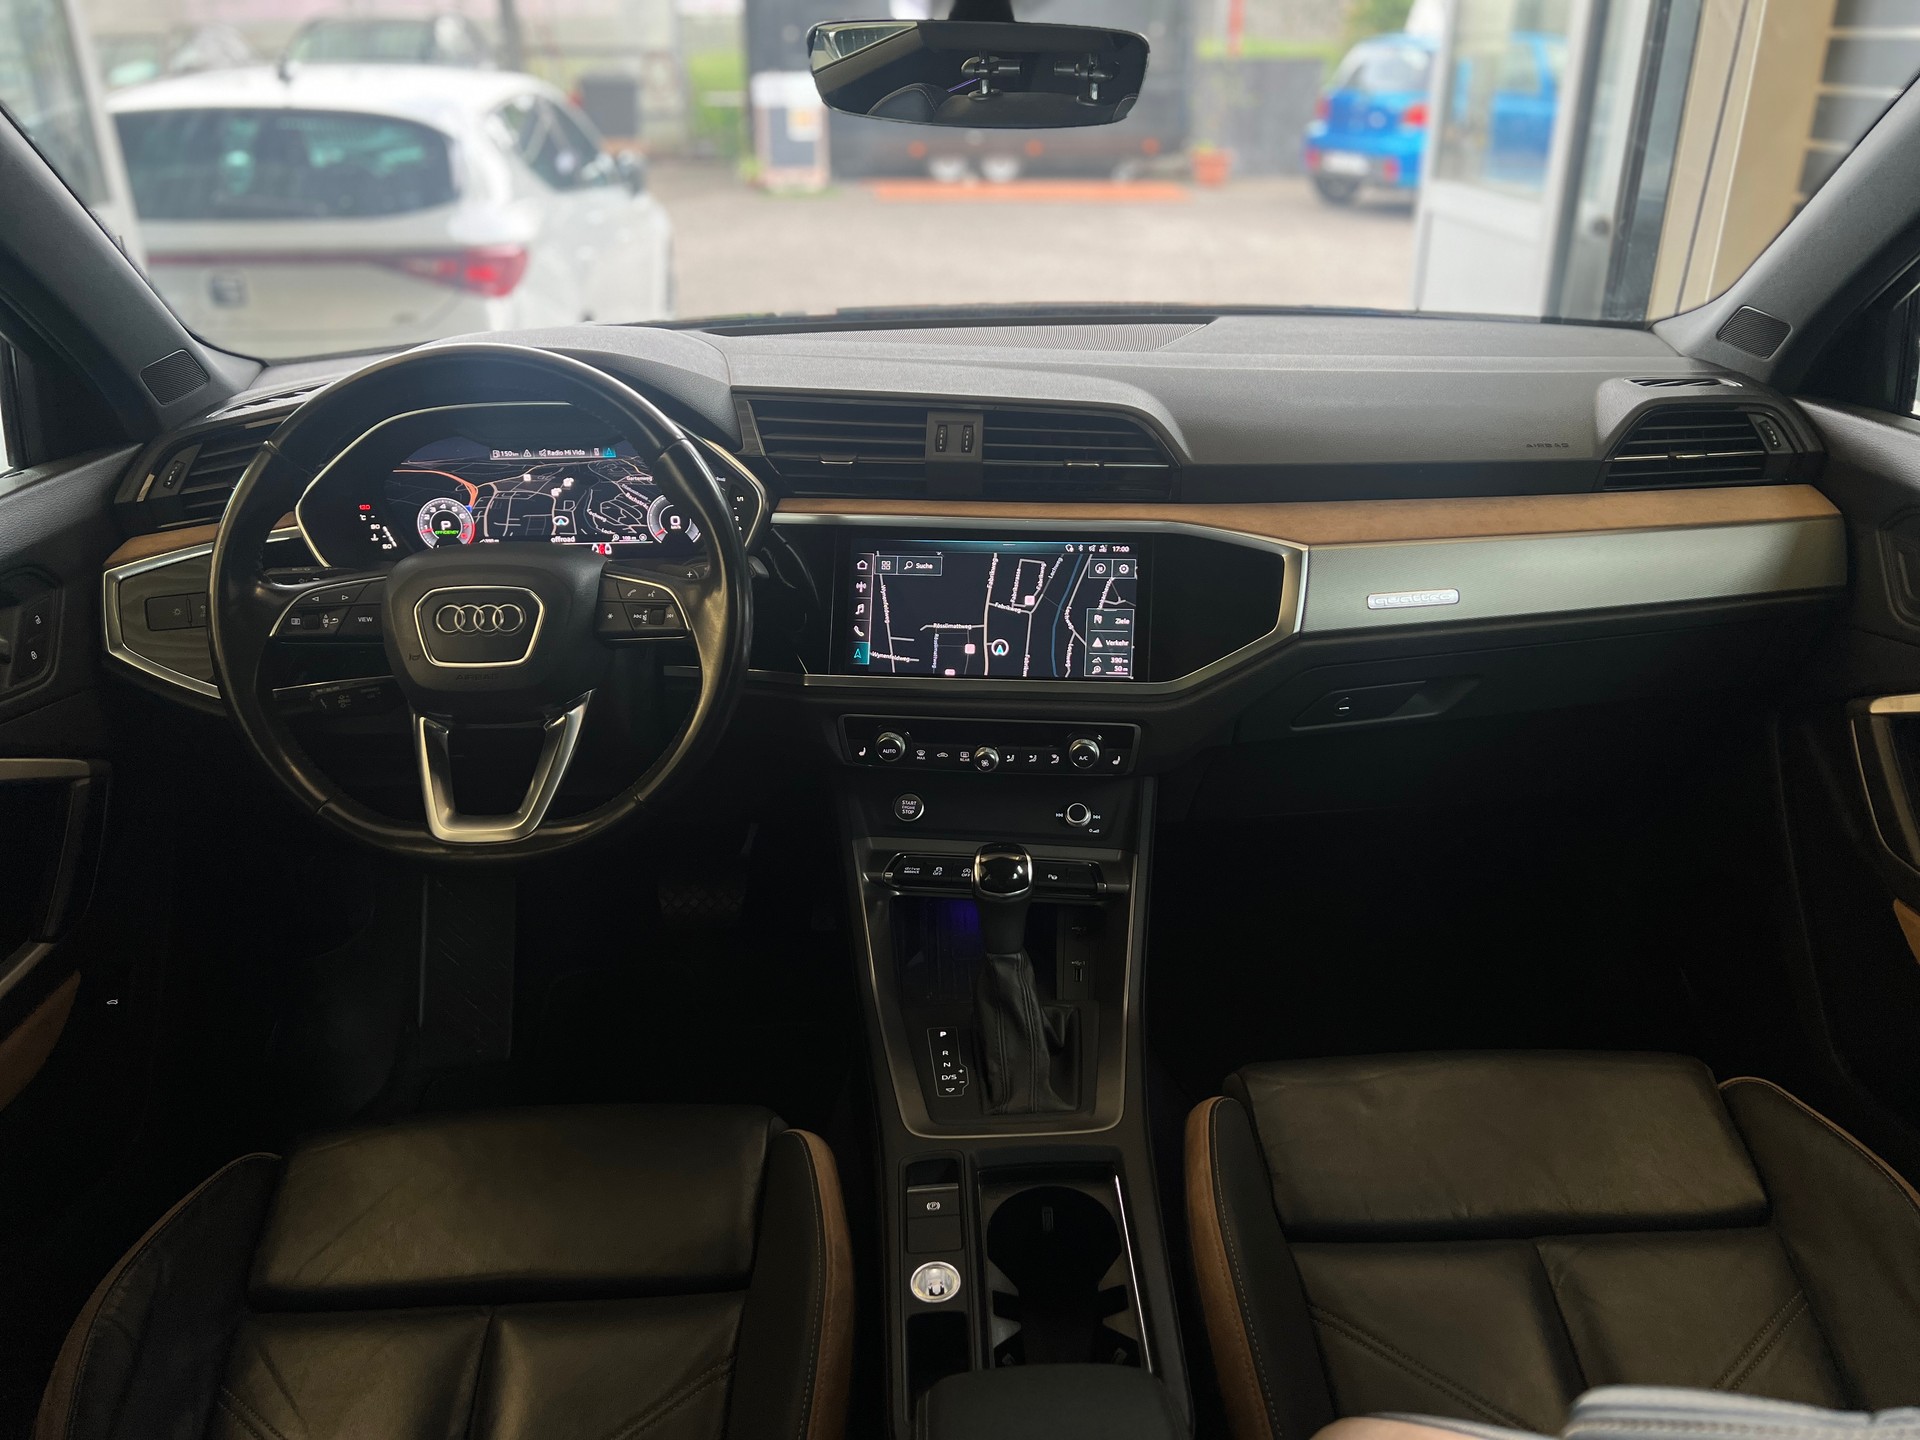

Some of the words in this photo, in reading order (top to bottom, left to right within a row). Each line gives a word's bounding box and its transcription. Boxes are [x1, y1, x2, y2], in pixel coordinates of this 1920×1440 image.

[440, 520, 452, 531] P
[669, 515, 681, 526] 0
[550, 535, 576, 543] offroad
[1112, 545, 1130, 553] 17:00
[915, 562, 933, 570] Suche
[986, 557, 999, 589] Fabrikweg
[1036, 562, 1047, 591] Fabrikweg
[880, 584, 890, 624] Wynenfeldweg
[1374, 592, 1454, 608] quattro
[994, 601, 1022, 614] Fabrikweg
[1115, 617, 1131, 625] Ziele
[1105, 638, 1130, 646] Verkehr
[871, 650, 911, 663] Wynenfeldweg
